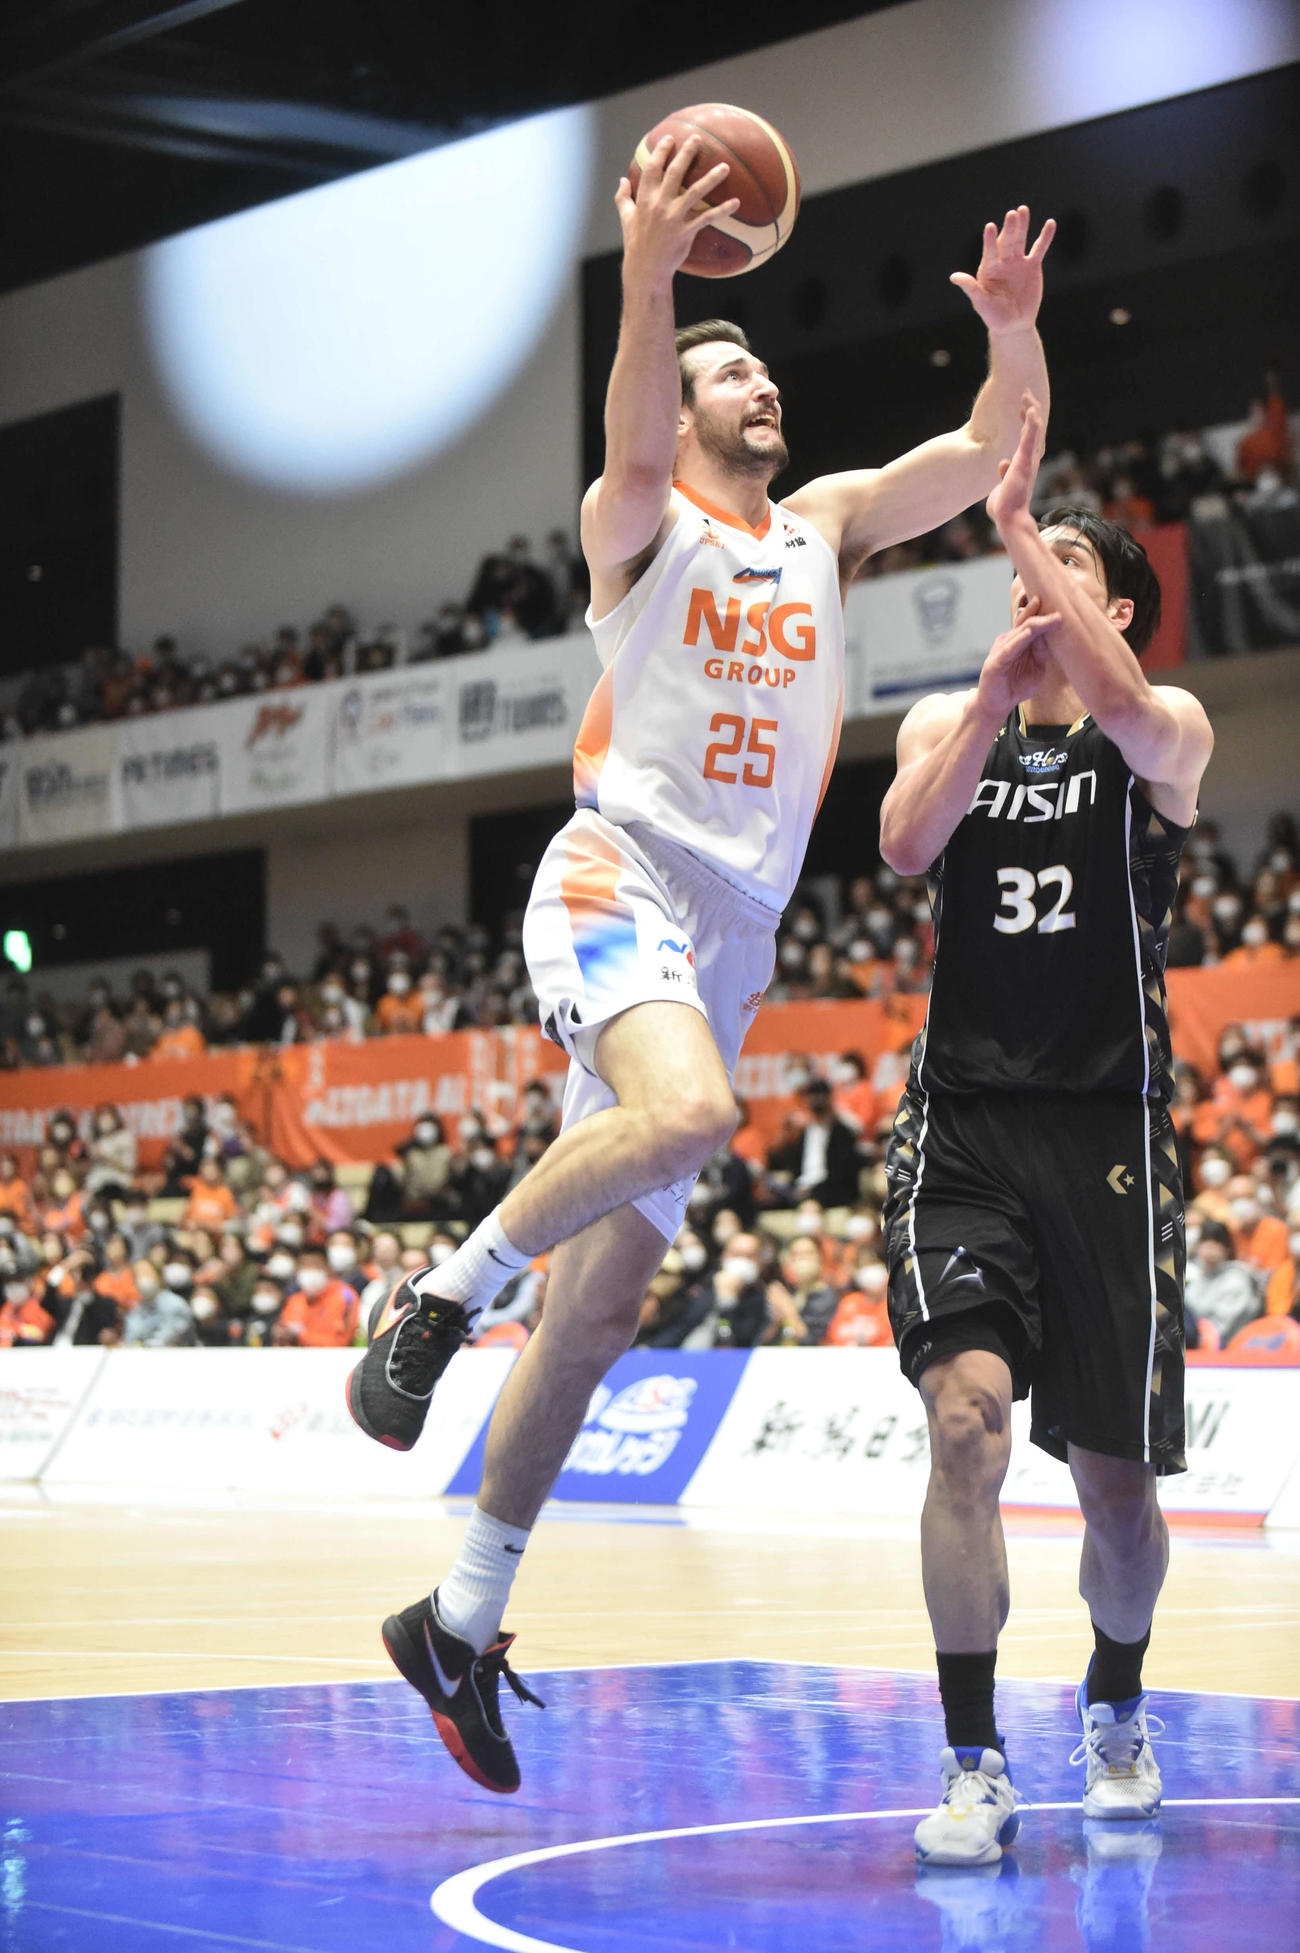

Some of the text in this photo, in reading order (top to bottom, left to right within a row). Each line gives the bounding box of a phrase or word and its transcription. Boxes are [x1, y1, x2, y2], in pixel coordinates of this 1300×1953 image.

[683, 587, 816, 662] NSG
[704, 658, 796, 689] GROUP
[703, 712, 778, 789] 25
[966, 769, 1097, 823] AISIN
[992, 864, 1077, 935] 32
